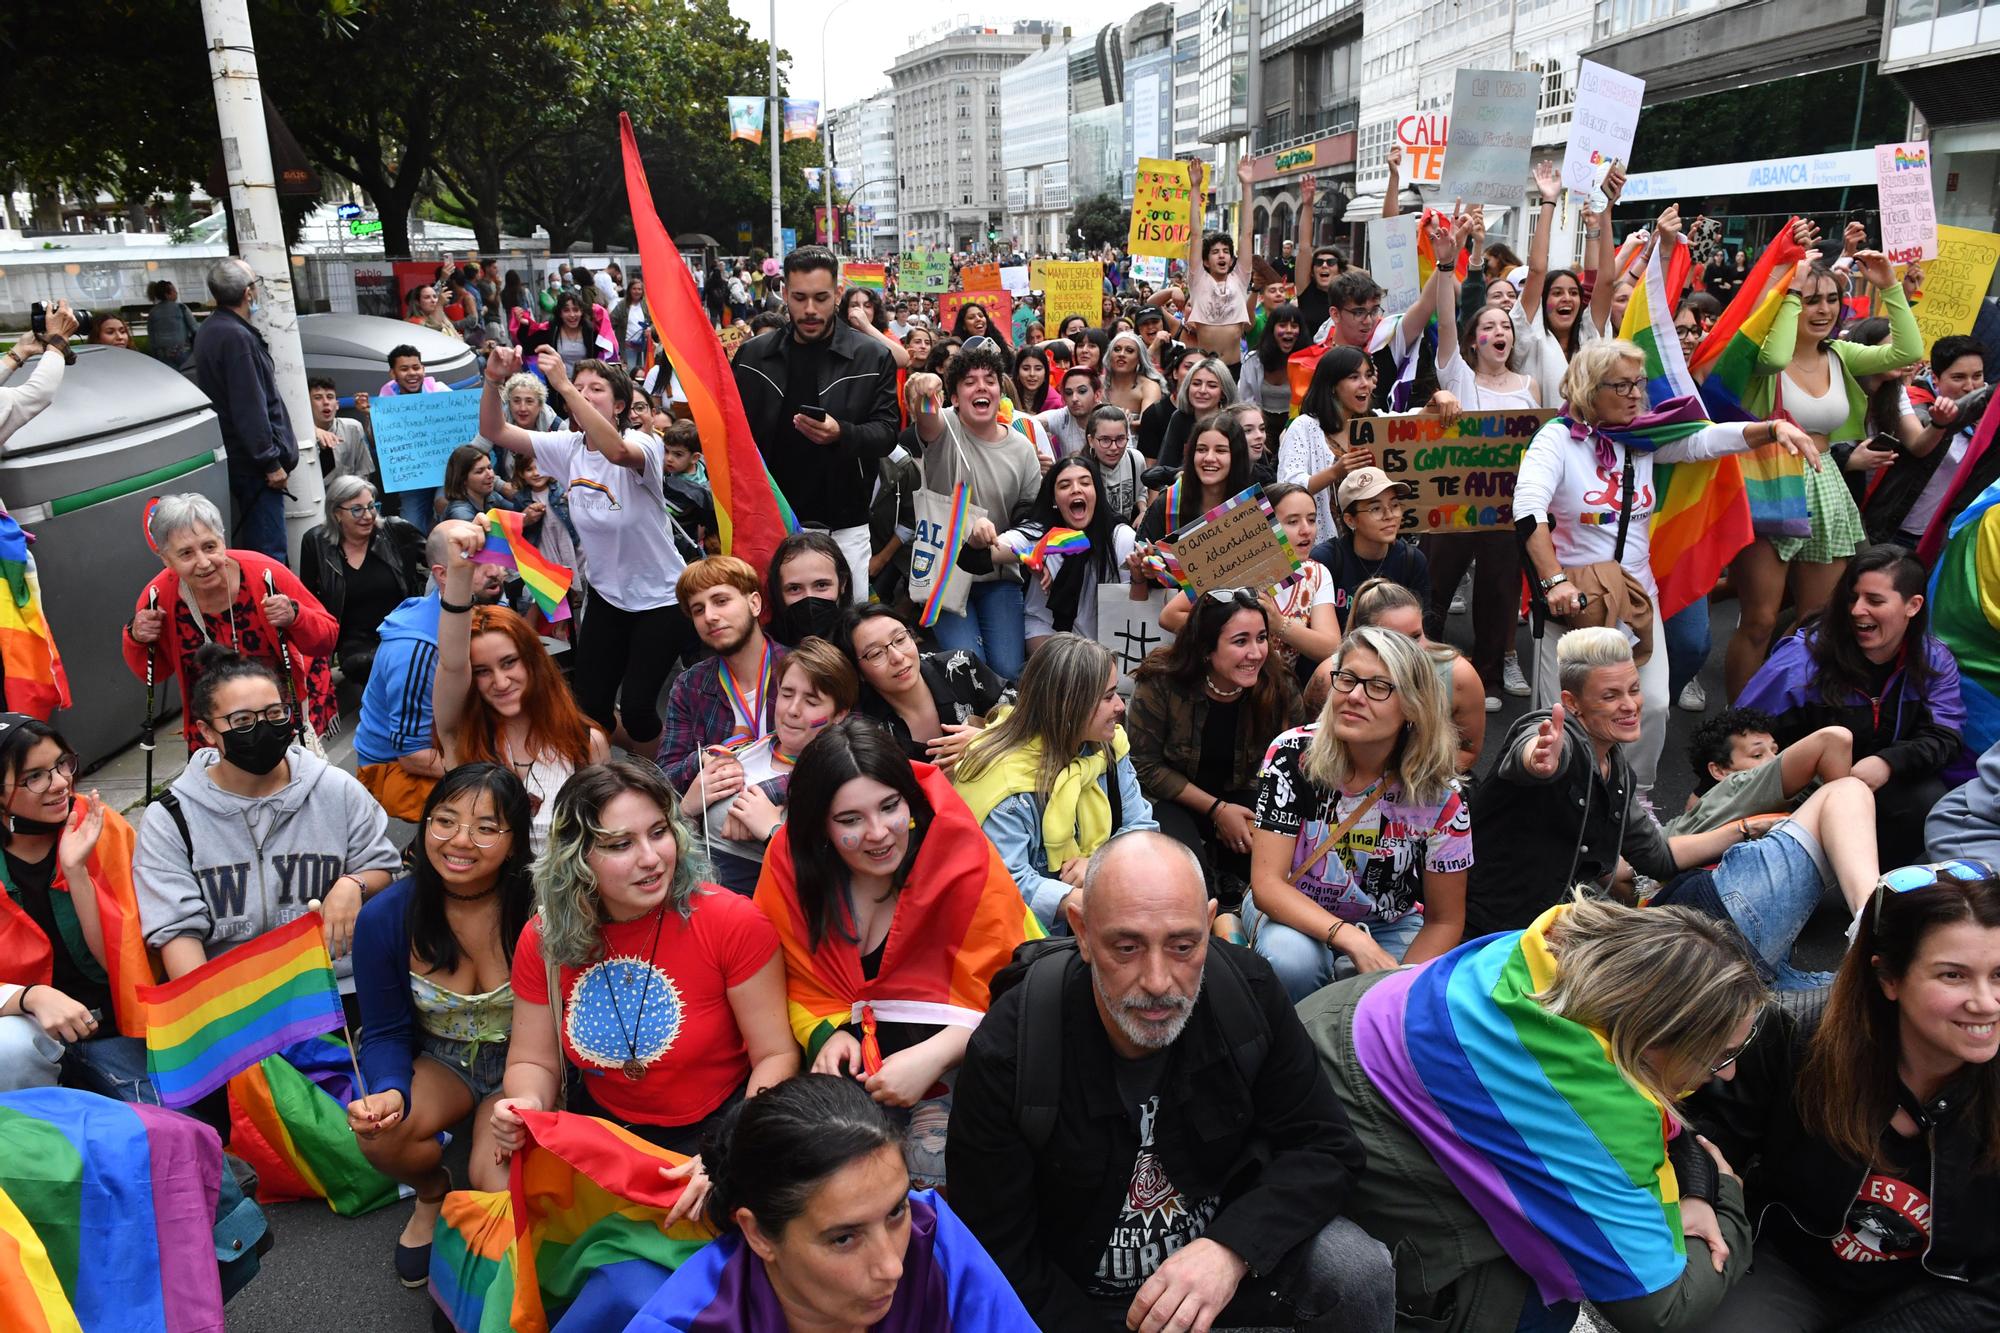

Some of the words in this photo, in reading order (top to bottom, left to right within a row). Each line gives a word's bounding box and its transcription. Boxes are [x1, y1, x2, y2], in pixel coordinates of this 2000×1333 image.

[1397, 112, 1447, 146] CÁLL
[1406, 146, 1445, 179] TE
[1895, 147, 1927, 172] AMOR
[1748, 165, 1807, 187] ABANCA
[1623, 180, 1648, 196] ANCA
[902, 252, 913, 261] XA
[1927, 260, 1973, 280] AMOR
[1056, 280, 1067, 291] NO
[1926, 297, 1970, 320] DAÑO
[1350, 419, 1375, 446] LA
[1383, 449, 1408, 472] ES
[1429, 476, 1460, 497] TE
[1464, 471, 1516, 497] ANTO
[1232, 504, 1261, 523] amor
[916, 519, 945, 549] AL
[1187, 561, 1199, 573] a
[1206, 520, 1270, 565] identidade
[1213, 540, 1274, 581] identidade
[1431, 853, 1472, 874] iginal
[271, 853, 344, 905] YOR
[1870, 1181, 1896, 1203] ES
